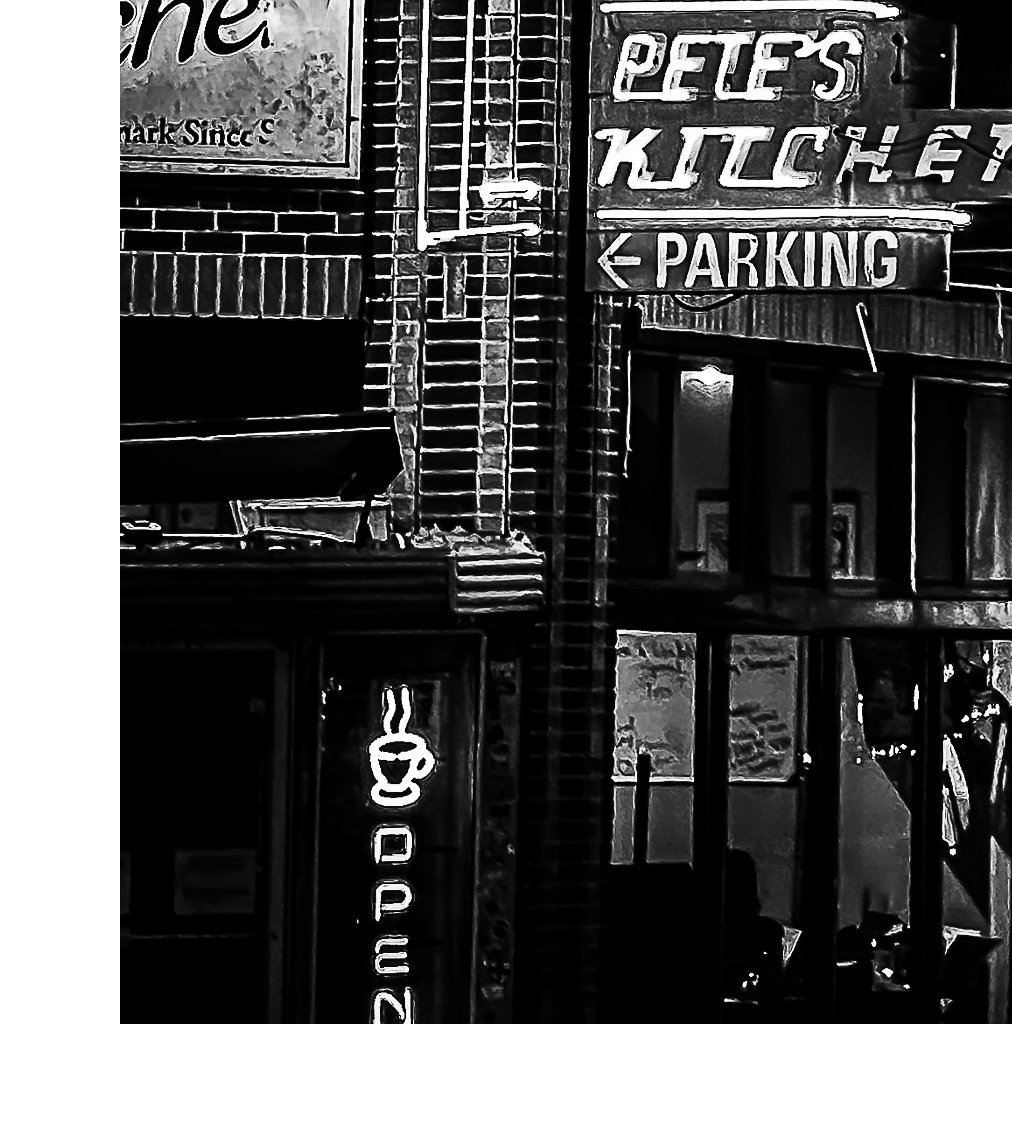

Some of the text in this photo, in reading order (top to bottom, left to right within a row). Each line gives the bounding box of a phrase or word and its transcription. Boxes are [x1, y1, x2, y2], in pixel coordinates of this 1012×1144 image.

[612, 28, 864, 103] PETE'S
[656, 231, 899, 289] PARKING
[372, 825, 414, 1024] OPEN
